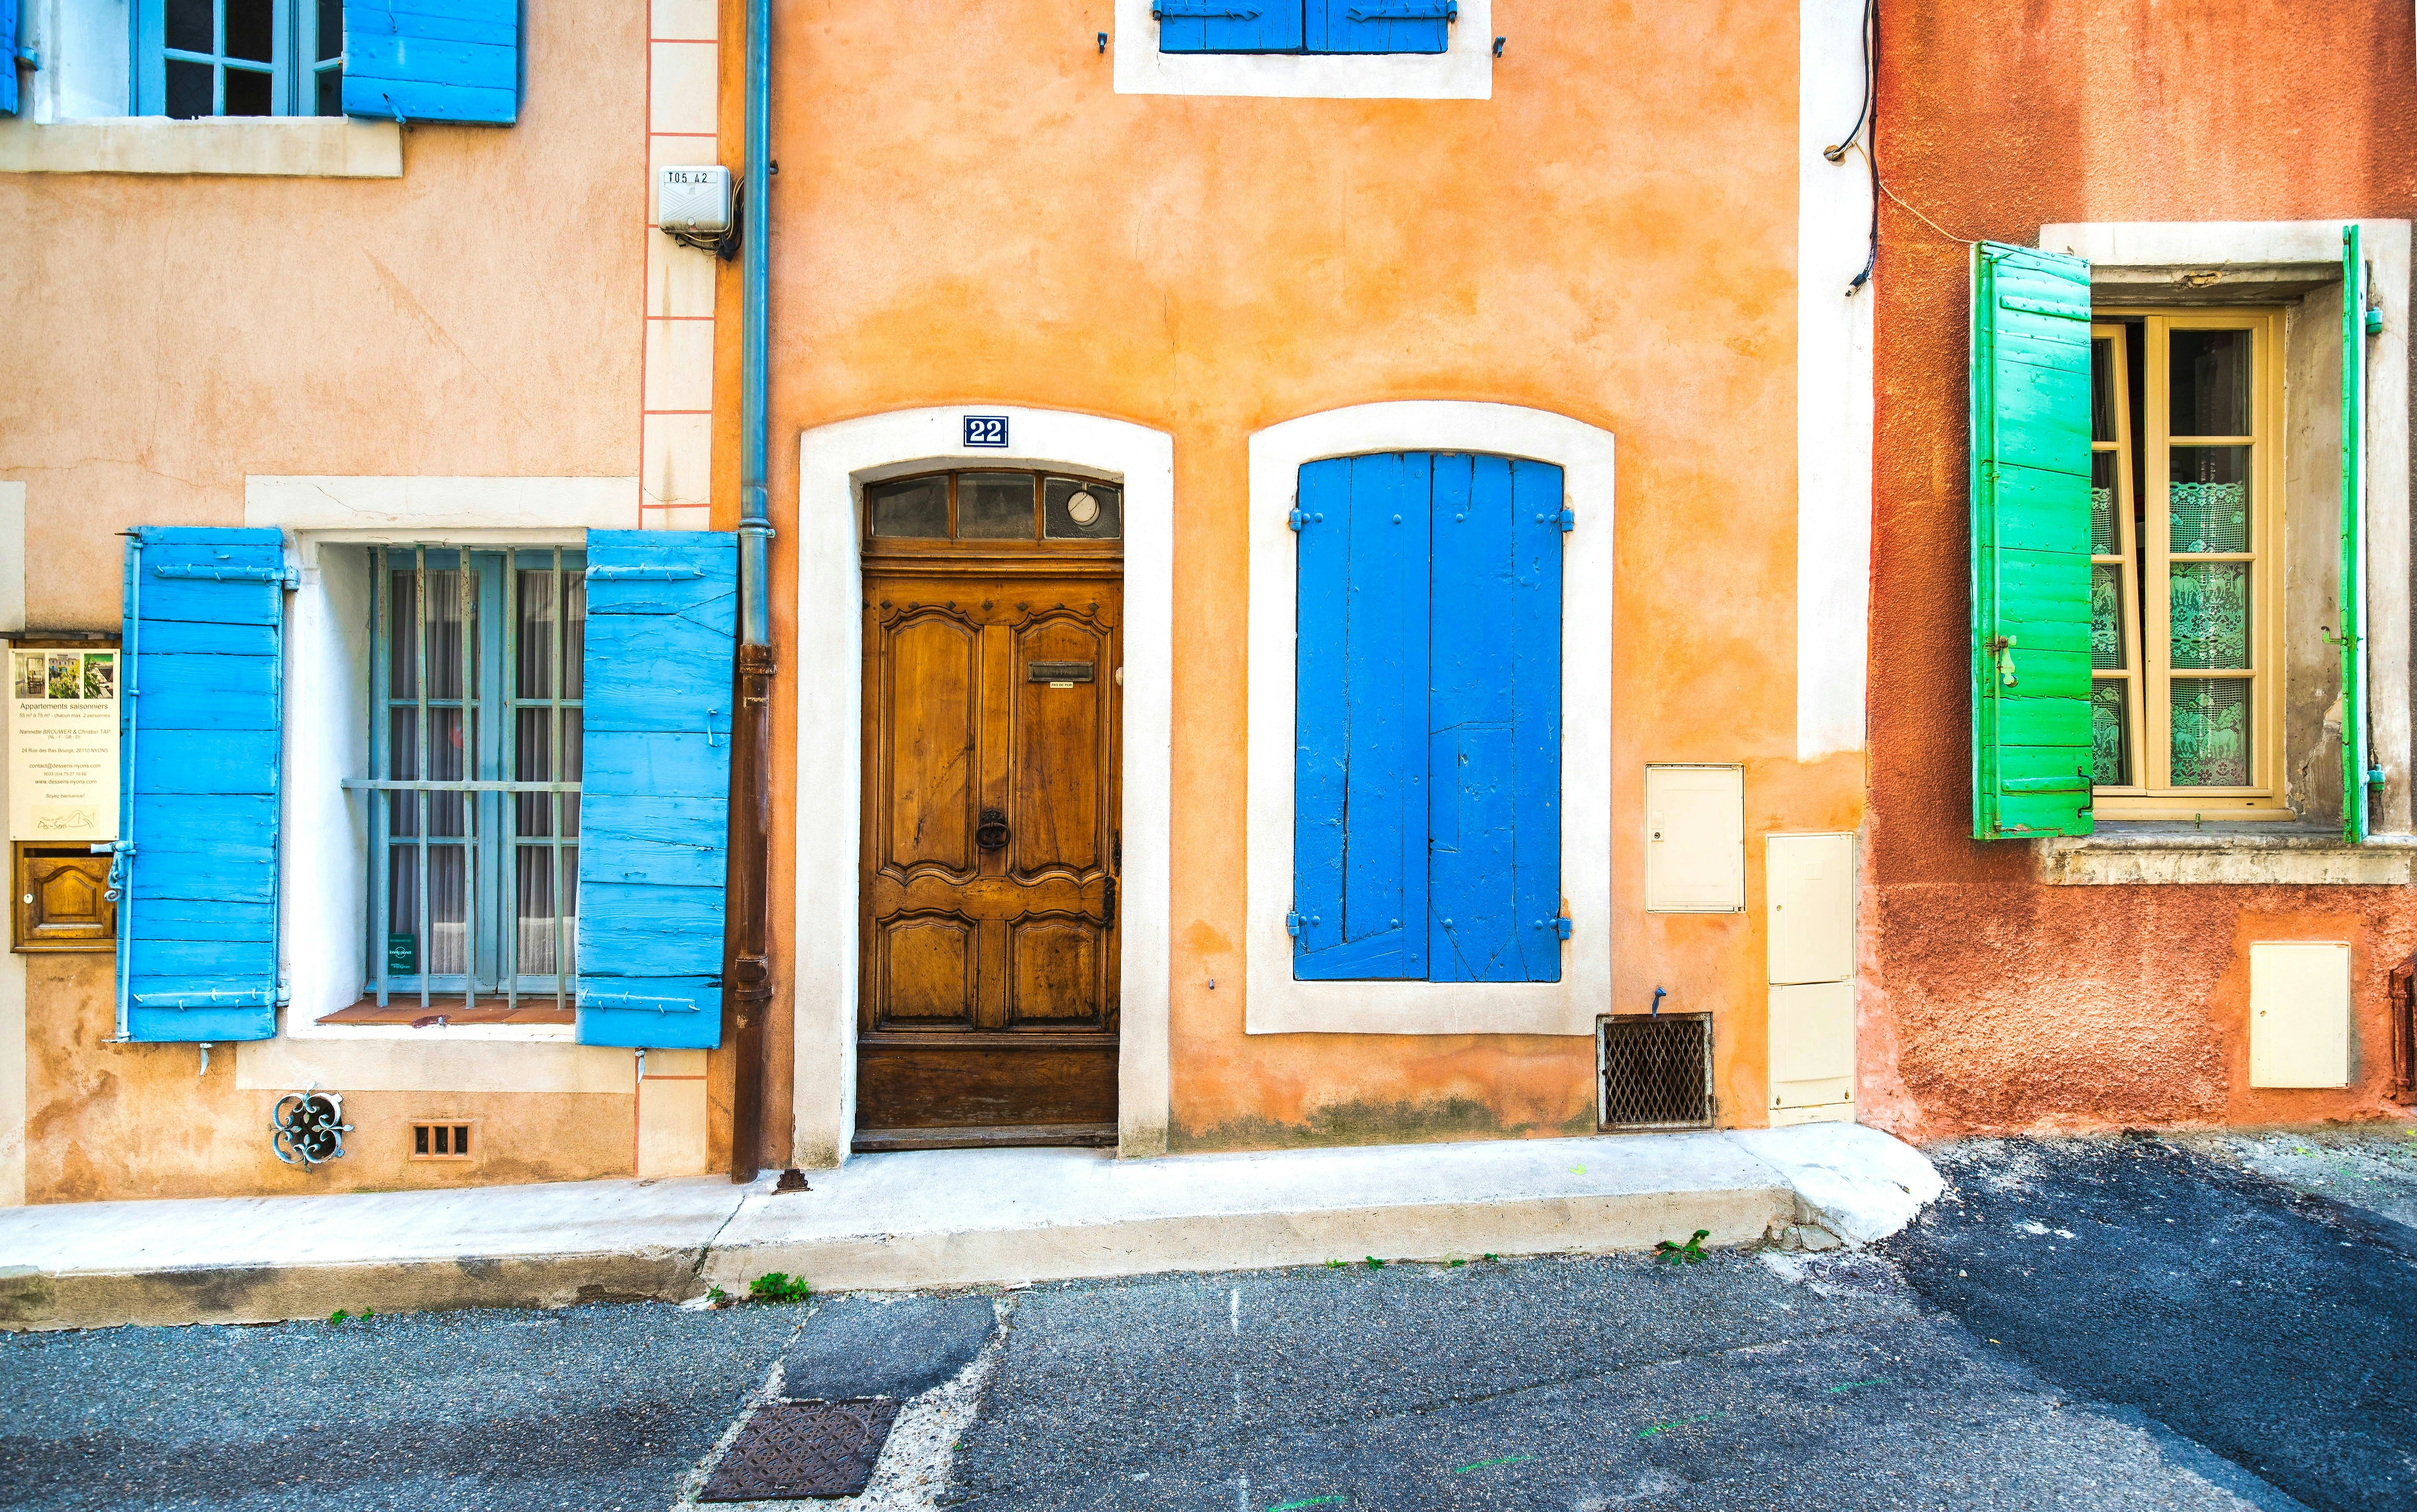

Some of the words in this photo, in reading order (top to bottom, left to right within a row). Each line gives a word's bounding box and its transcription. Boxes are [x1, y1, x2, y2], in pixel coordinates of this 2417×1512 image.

[669, 172, 687, 183] T05
[695, 173, 707, 183] A2
[970, 420, 1001, 441] 22
[20, 703, 67, 711] Appartements
